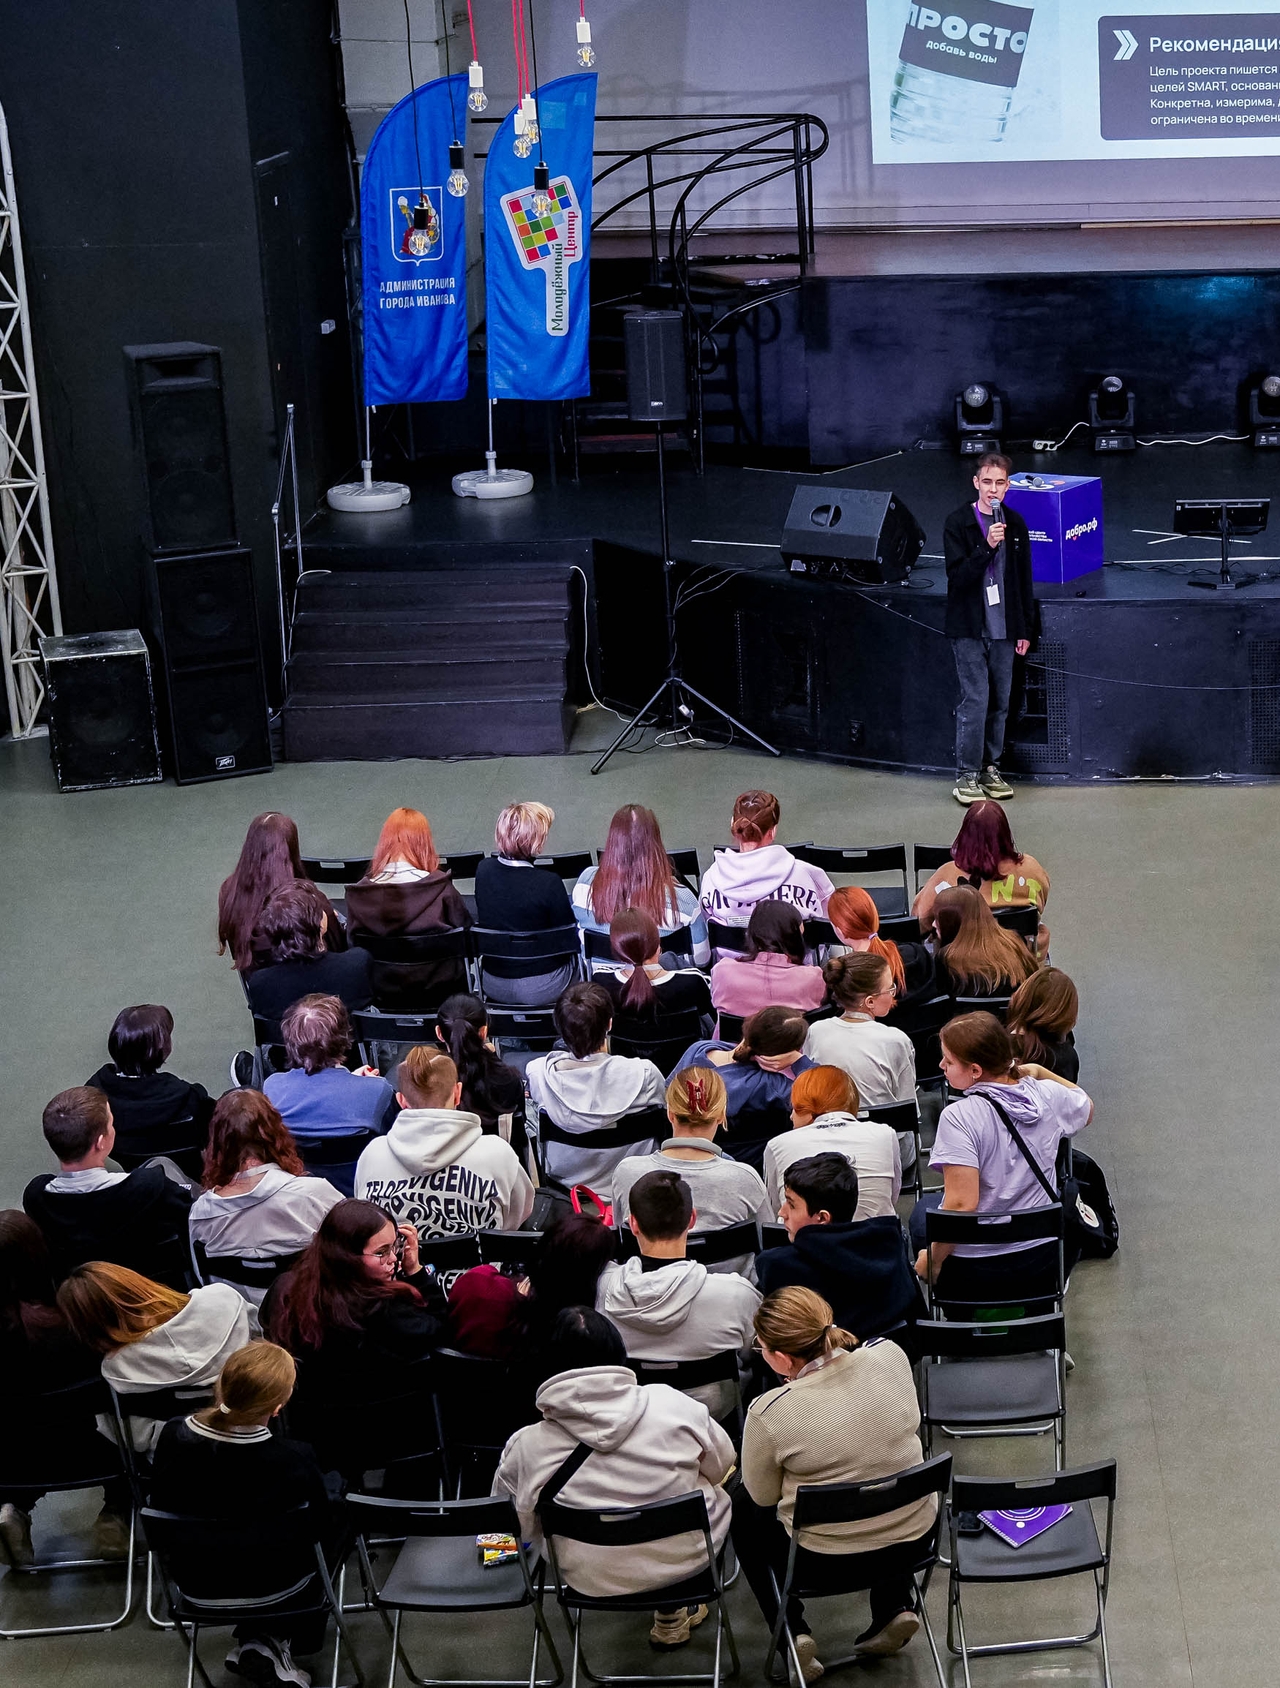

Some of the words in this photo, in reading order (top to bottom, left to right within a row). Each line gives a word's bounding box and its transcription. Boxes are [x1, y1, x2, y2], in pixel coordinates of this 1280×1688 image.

[926, 40, 966, 56] добавь
[968, 51, 998, 64] воды
[1150, 66, 1179, 77] Цель
[1181, 66, 1227, 78] проекта
[1229, 65, 1278, 75] пишется
[1150, 82, 1185, 93] целей
[1187, 81, 1229, 93] SMART,
[1150, 98, 1214, 110] Конкретна,
[1216, 97, 1276, 109] измерима,
[1150, 115, 1218, 127] ограничена
[1220, 115, 1234, 124] во
[564, 211, 578, 257] Центр
[379, 277, 456, 294] АДМИНИСТРАЦИЯ
[551, 243, 567, 331] Молодёжный
[380, 296, 415, 310] ГОРОДА
[1065, 517, 1098, 540] добро.рф
